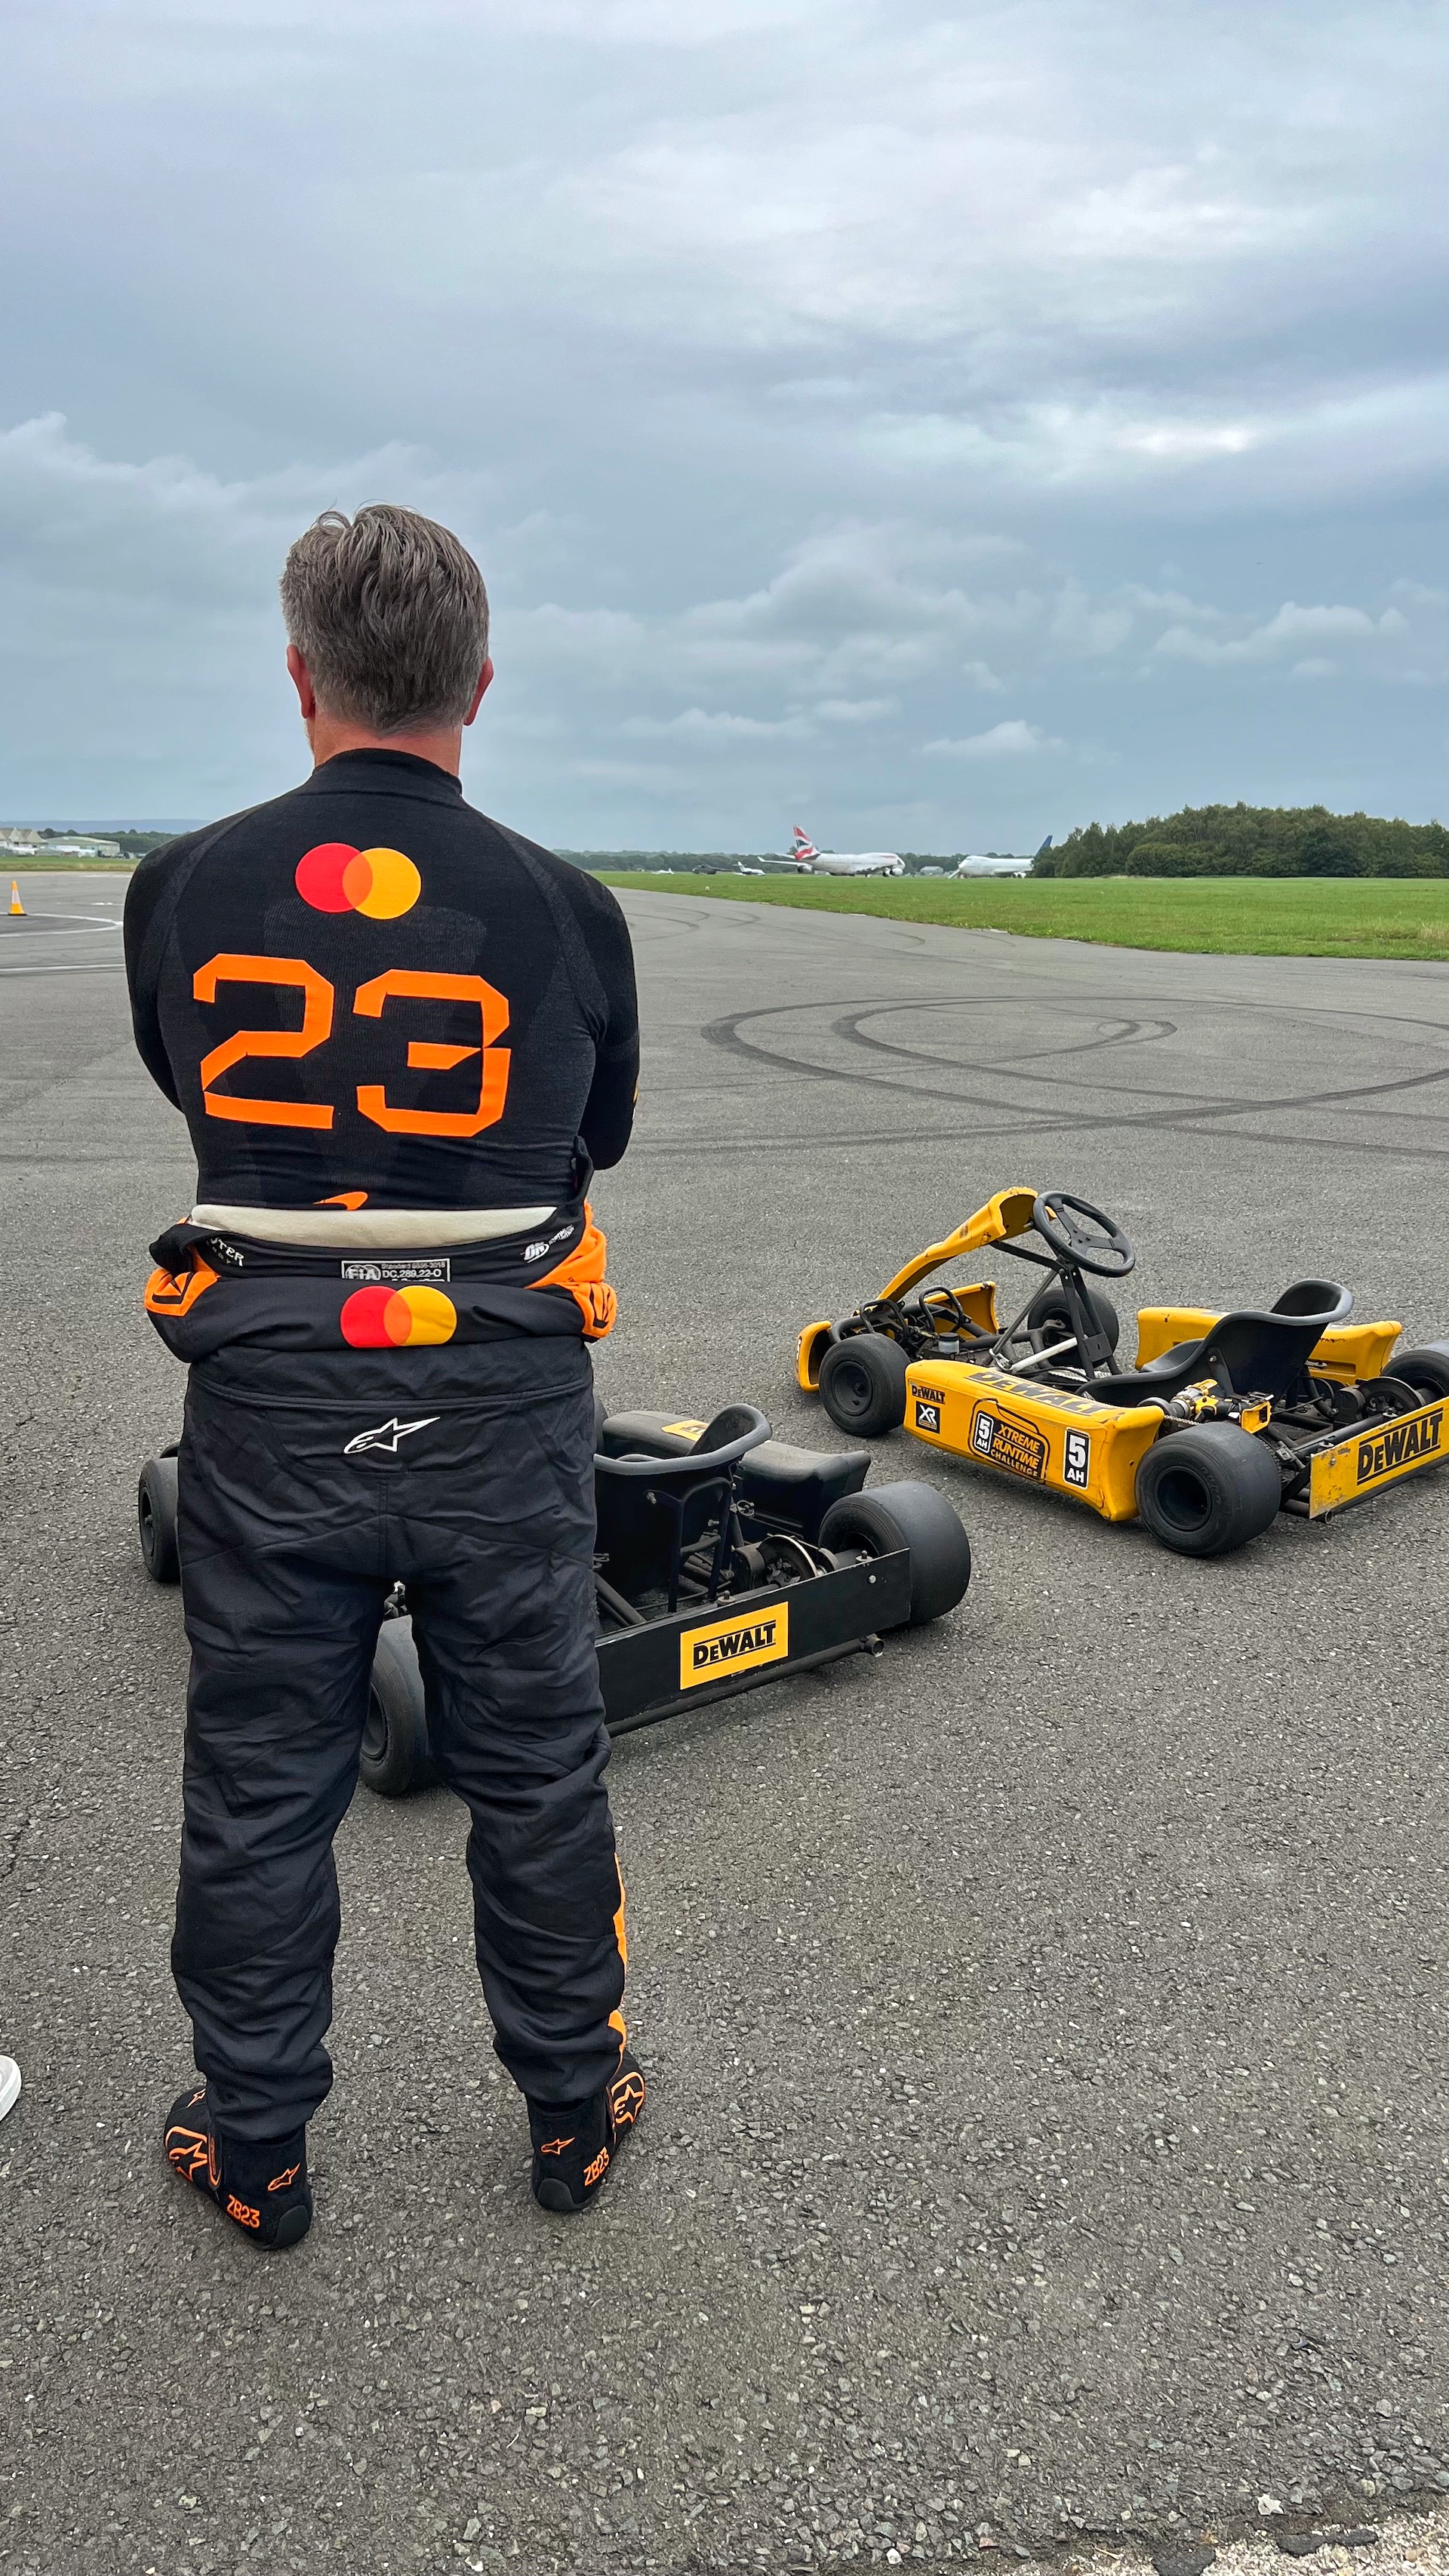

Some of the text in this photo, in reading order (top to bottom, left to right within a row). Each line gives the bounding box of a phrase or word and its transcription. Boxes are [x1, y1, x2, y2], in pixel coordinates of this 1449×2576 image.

[193, 953, 512, 1137] 23
[918, 1404, 937, 1424] XR
[978, 1417, 991, 1440] 5
[977, 1437, 988, 1449] AH
[992, 1437, 1040, 1470] RUNTIME
[998, 1423, 1041, 1453] XTREME
[1068, 1434, 1087, 1468] 5
[1358, 1412, 1443, 1481] DEWALT
[990, 1449, 1038, 1478] CHALLENGE
[1066, 1467, 1085, 1484] AH
[693, 1623, 777, 1667] DEWALT
[583, 2147, 610, 2187] ZB23
[227, 2194, 260, 2229] ZB23
